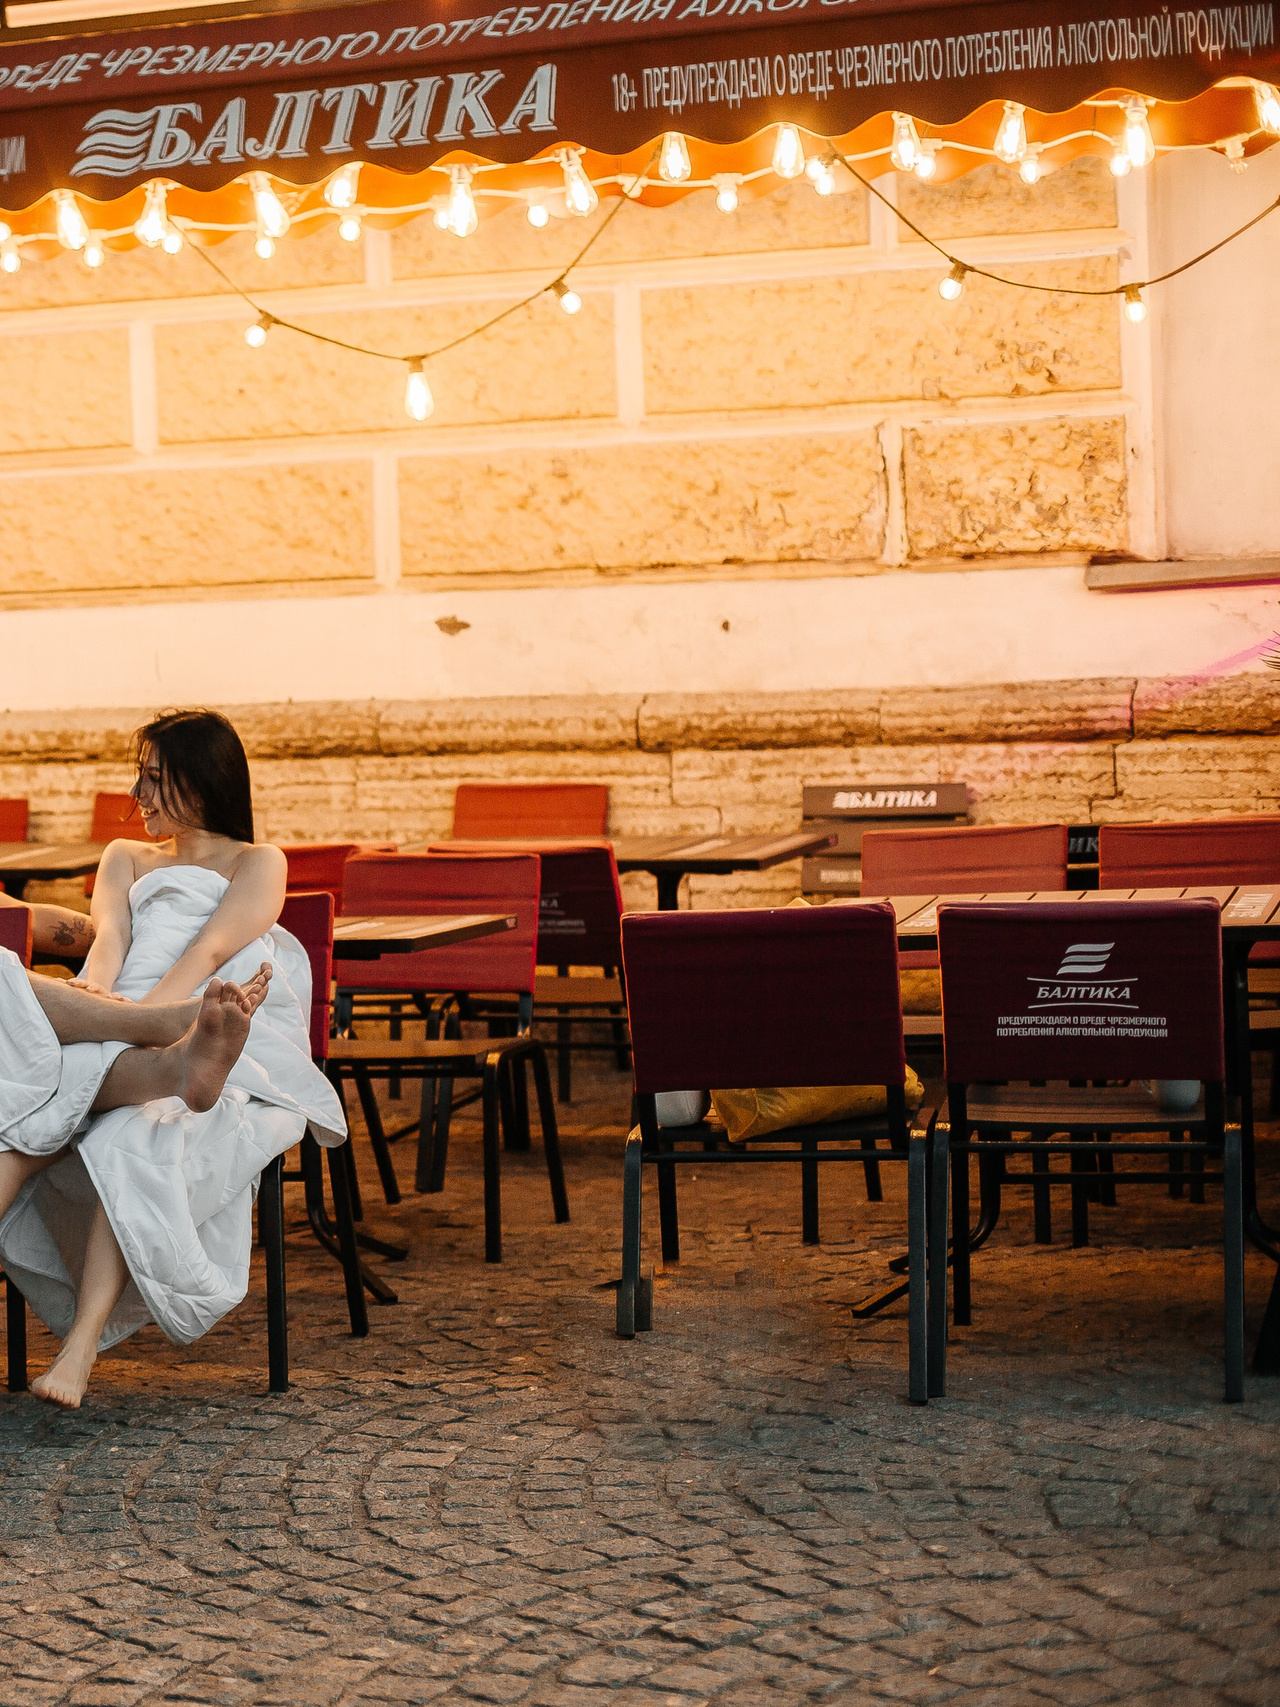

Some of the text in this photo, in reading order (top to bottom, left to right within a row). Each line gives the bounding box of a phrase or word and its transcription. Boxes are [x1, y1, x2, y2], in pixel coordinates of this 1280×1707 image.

[100, 30, 380, 78] ЧРЕЗМЕРНОГО
[376, 0, 671, 56] ПОТРЕБЛЕНИЯ
[611, 3, 1275, 115] 18+ ПРЕДУПРЕЖДАЕМ О ВРЕДЕ ЧРЕЗМЕРНОГО ПОТРЕБЛЕНИЯ АЛКОГОЛЬНОЙ ПРОДУКЦИИ
[138, 62, 558, 171] БАЛТИКА
[1036, 986, 1131, 999] БАЛТИКА
[996, 1026, 1168, 1038] ПОТРЕБЛЕНИЯ АЛКОГОЛЬНОЙ ПРОДУКЦИИ
[997, 1015, 1167, 1027] ПРЕДУПРЕЖДАЕМ О ВРЕДЕ ЧРЕЗМЕРНОГО
